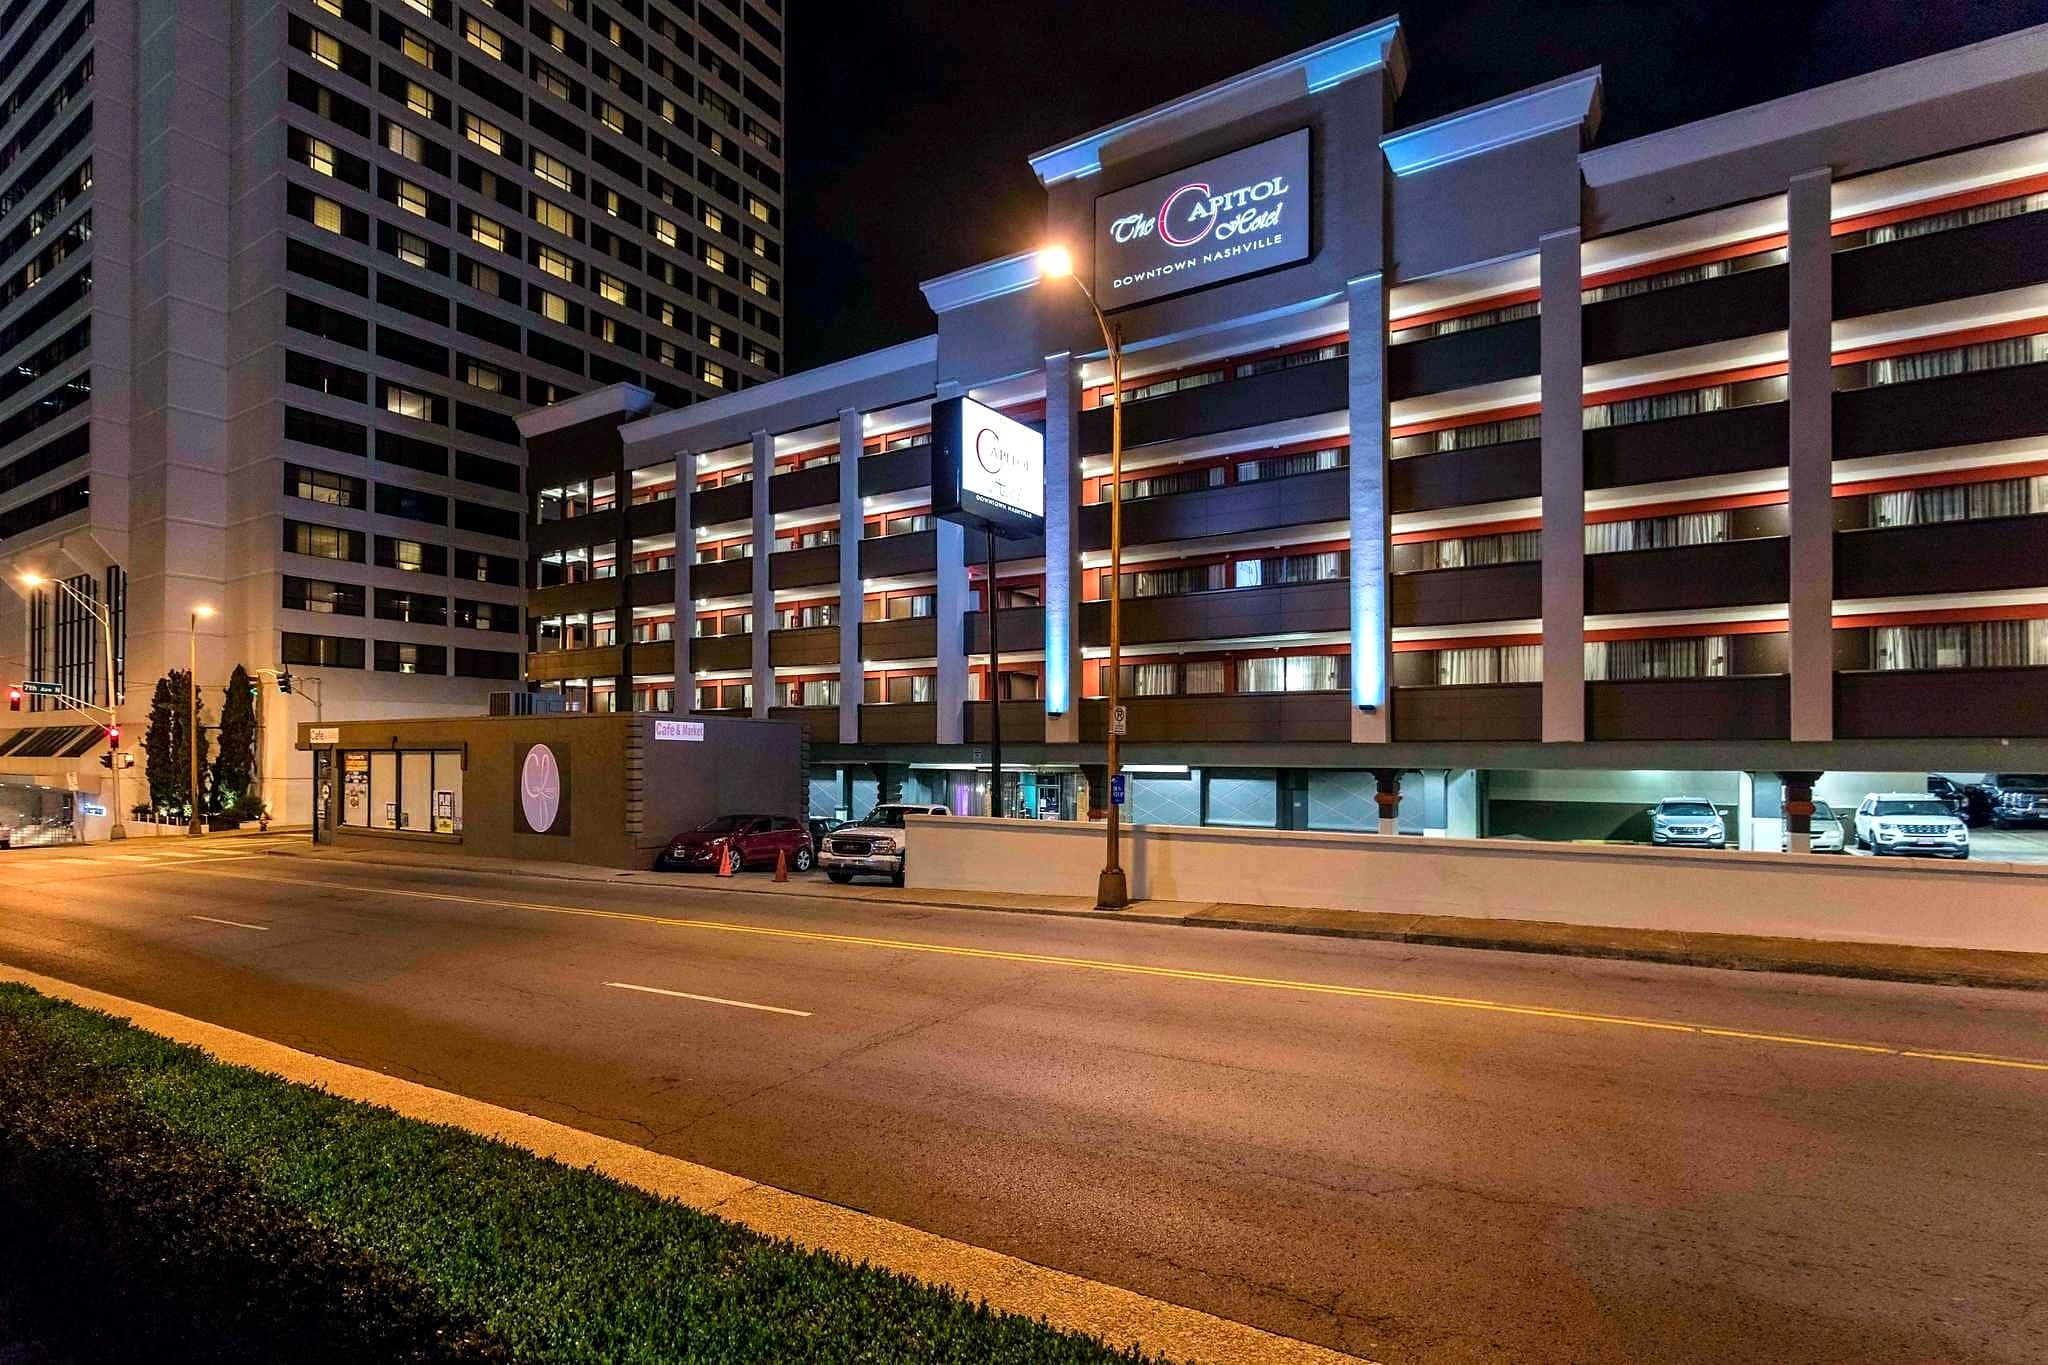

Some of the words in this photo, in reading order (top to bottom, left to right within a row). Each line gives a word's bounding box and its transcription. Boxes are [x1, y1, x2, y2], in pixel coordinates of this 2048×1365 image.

[1110, 213, 1156, 243] The
[1158, 176, 1289, 247] CAPITOL
[1215, 201, 1284, 240] Hotel
[1113, 258, 1197, 288] DOWNTOWN
[1203, 233, 1283, 264] NASHVILLE
[656, 722, 675, 736] Cafe
